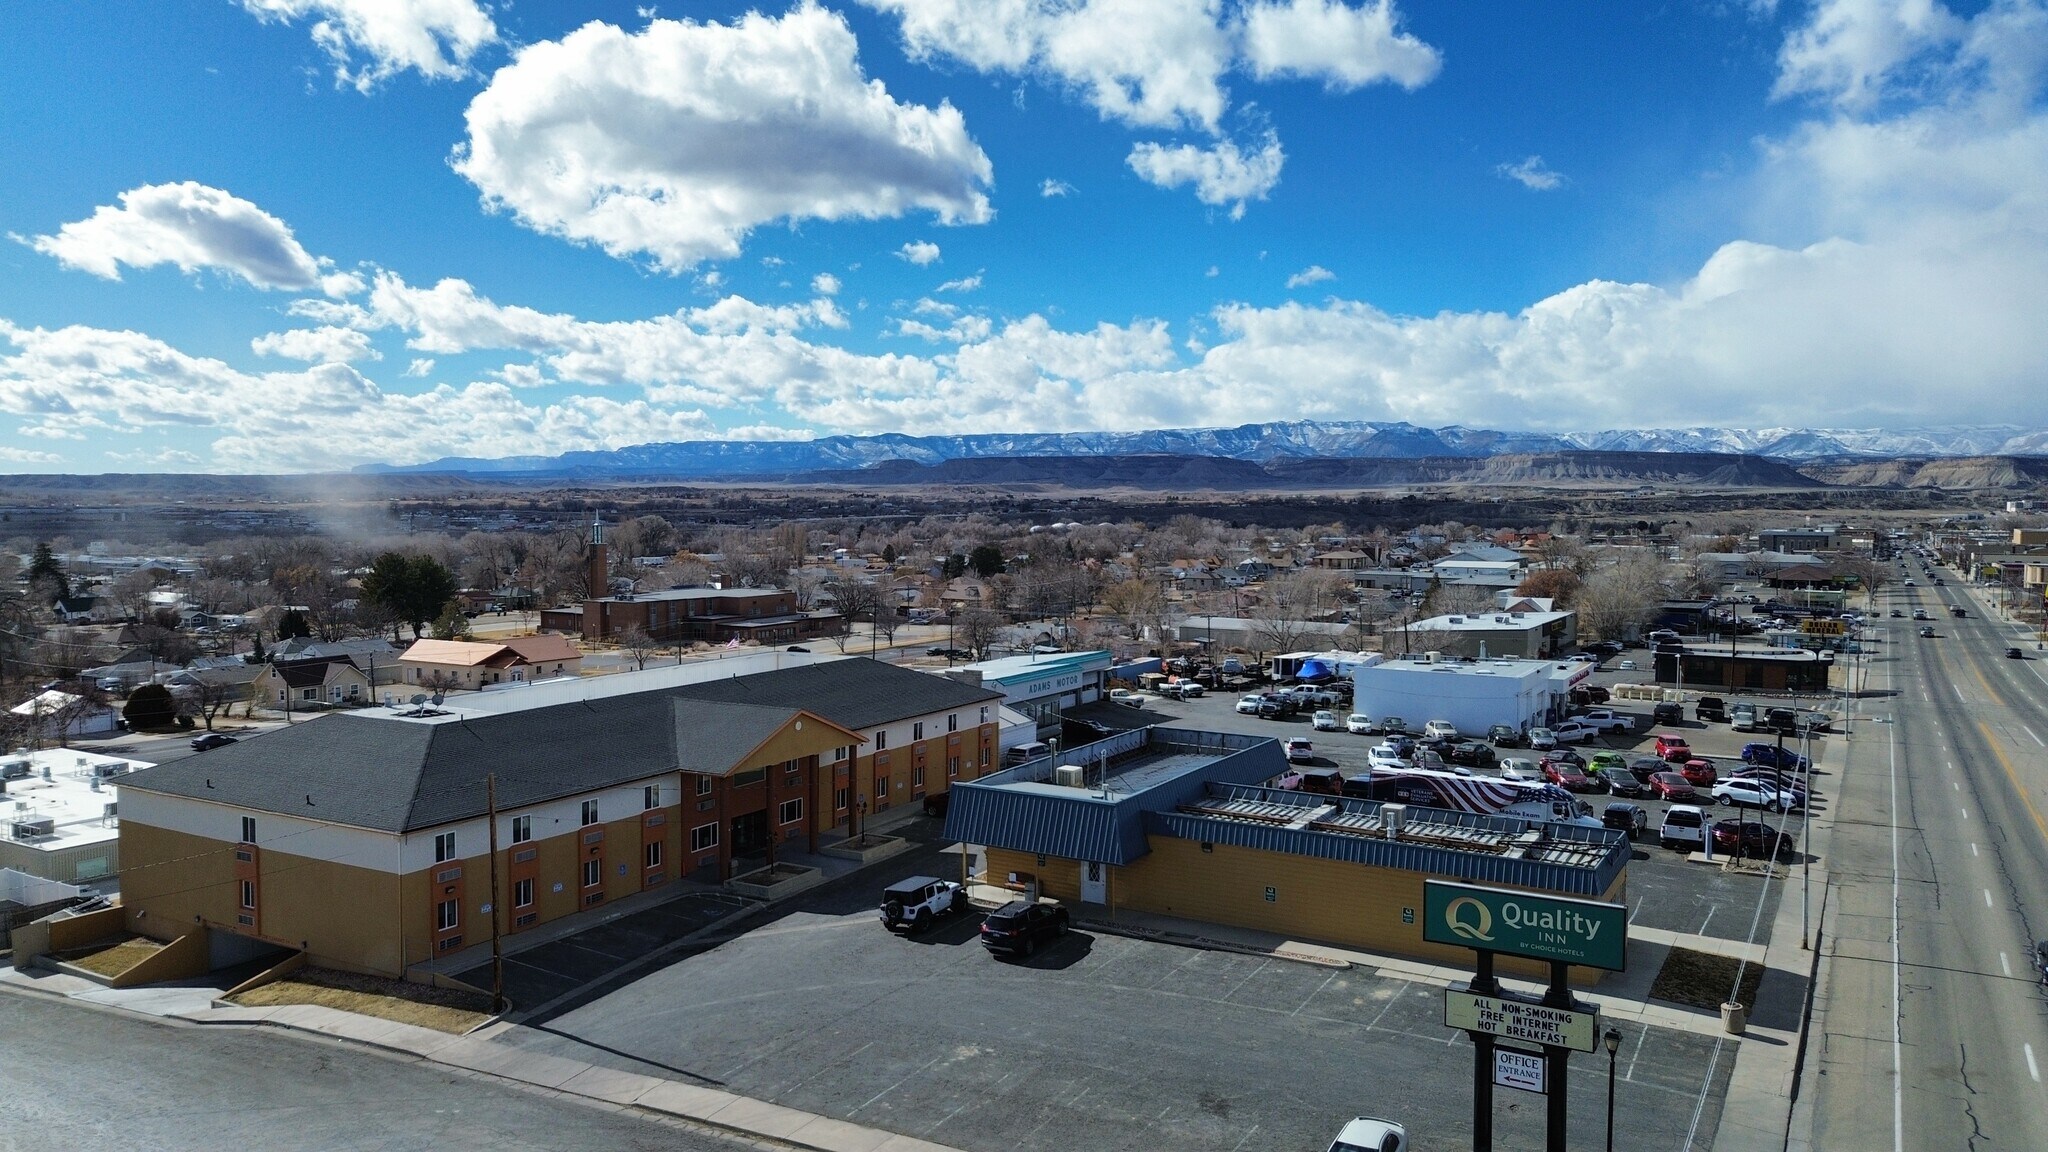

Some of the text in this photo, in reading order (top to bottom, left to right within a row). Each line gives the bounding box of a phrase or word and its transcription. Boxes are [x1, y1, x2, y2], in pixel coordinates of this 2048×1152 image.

[1029, 674, 1078, 694] ADAMS MOTOR
[1501, 902, 1601, 941] Quality
[1538, 931, 1567, 945] INN
[1520, 941, 1585, 957] BY CHOICE HOTELS
[1473, 998, 1573, 1024] ALL NON-SMOKING
[1480, 1010, 1561, 1032] FREE INTERNET
[1477, 1020, 1568, 1045] HOT BREAKFAST
[1500, 1053, 1539, 1070] OFFICE
[1498, 1064, 1541, 1080] ENTRANCE
